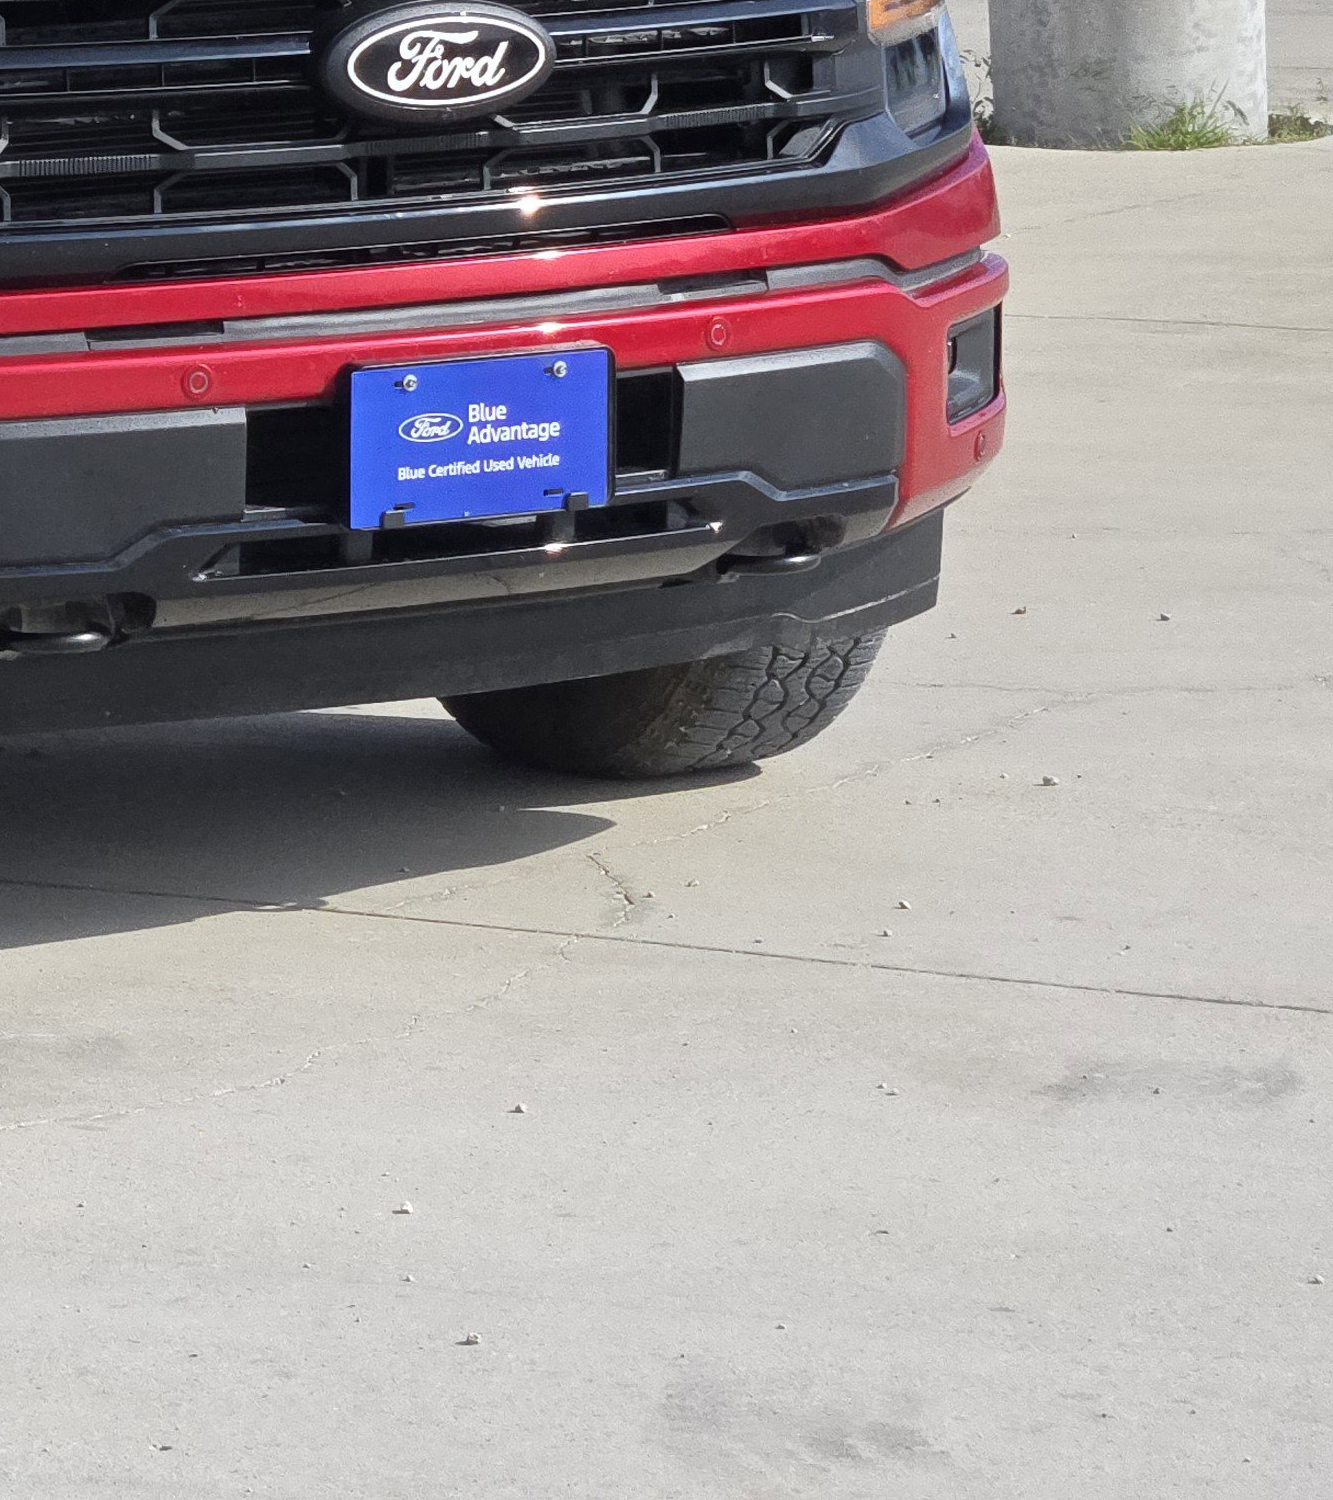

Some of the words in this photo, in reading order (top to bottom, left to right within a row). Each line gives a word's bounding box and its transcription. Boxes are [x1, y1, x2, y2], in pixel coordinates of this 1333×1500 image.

[386, 29, 510, 92] Ford
[468, 403, 507, 423] Blue
[410, 417, 452, 439] Ford
[467, 420, 561, 445] Advantage
[397, 466, 426, 481] Blue
[428, 460, 481, 476] Certified
[483, 458, 515, 473] Used
[517, 453, 561, 470] Vehicle
